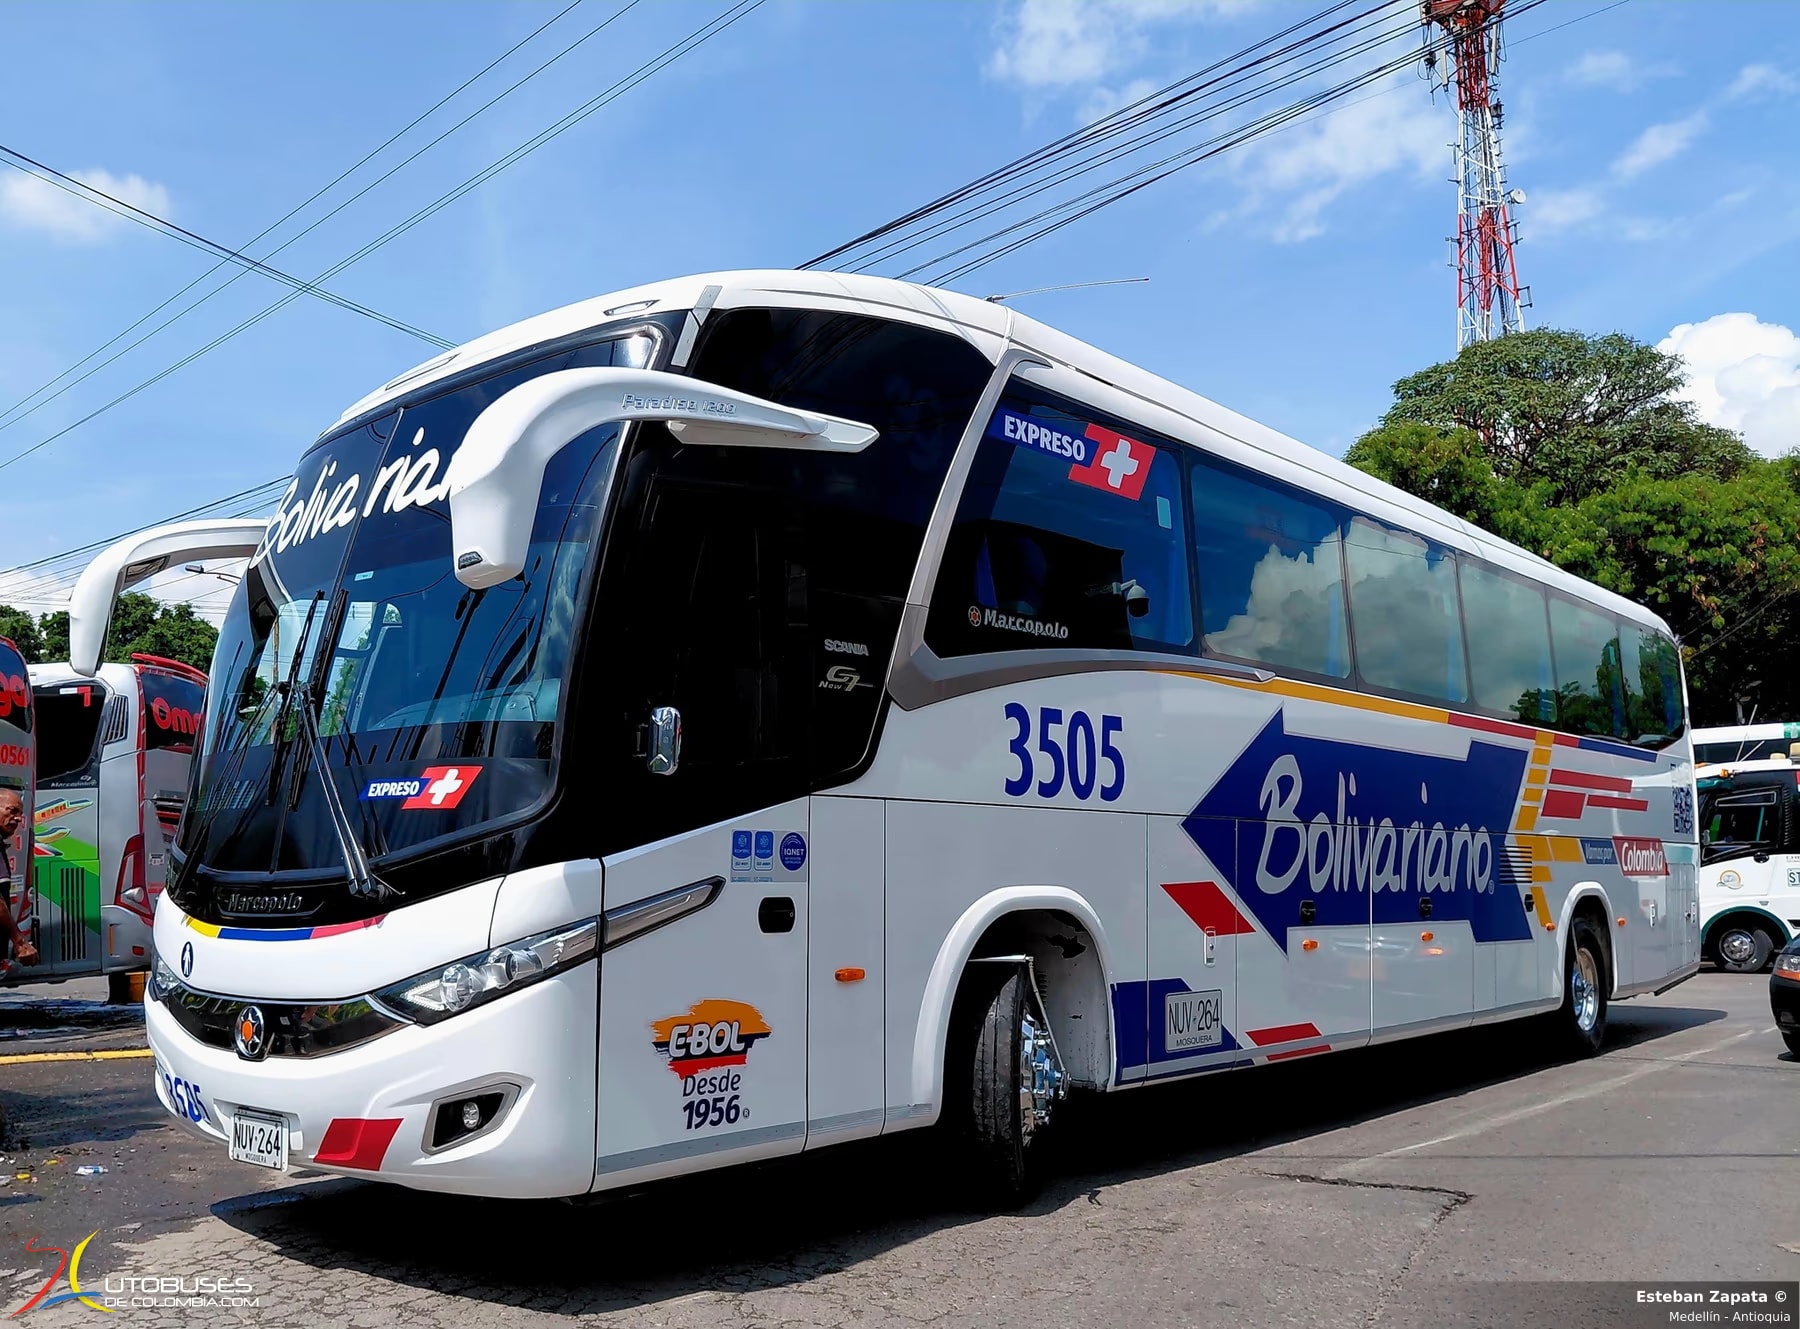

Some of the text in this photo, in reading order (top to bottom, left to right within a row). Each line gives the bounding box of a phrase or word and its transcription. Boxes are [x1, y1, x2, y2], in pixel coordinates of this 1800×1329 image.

[622, 393, 697, 412] Paradiso
[1003, 414, 1086, 463] EXPRESO
[983, 608, 1069, 639] Marcopolo
[824, 638, 869, 656] SCANIA
[1003, 701, 1126, 802] 3505
[367, 780, 420, 797] EXPRESO
[1256, 754, 1492, 895] Bolivariano
[1621, 841, 1664, 872] Colombia
[227, 892, 303, 912] Marcopolo
[1176, 1034, 1213, 1047] MOSQUERA
[165, 1072, 212, 1125] 3505
[683, 1069, 741, 1097] Desde
[683, 1095, 740, 1130] 1956
